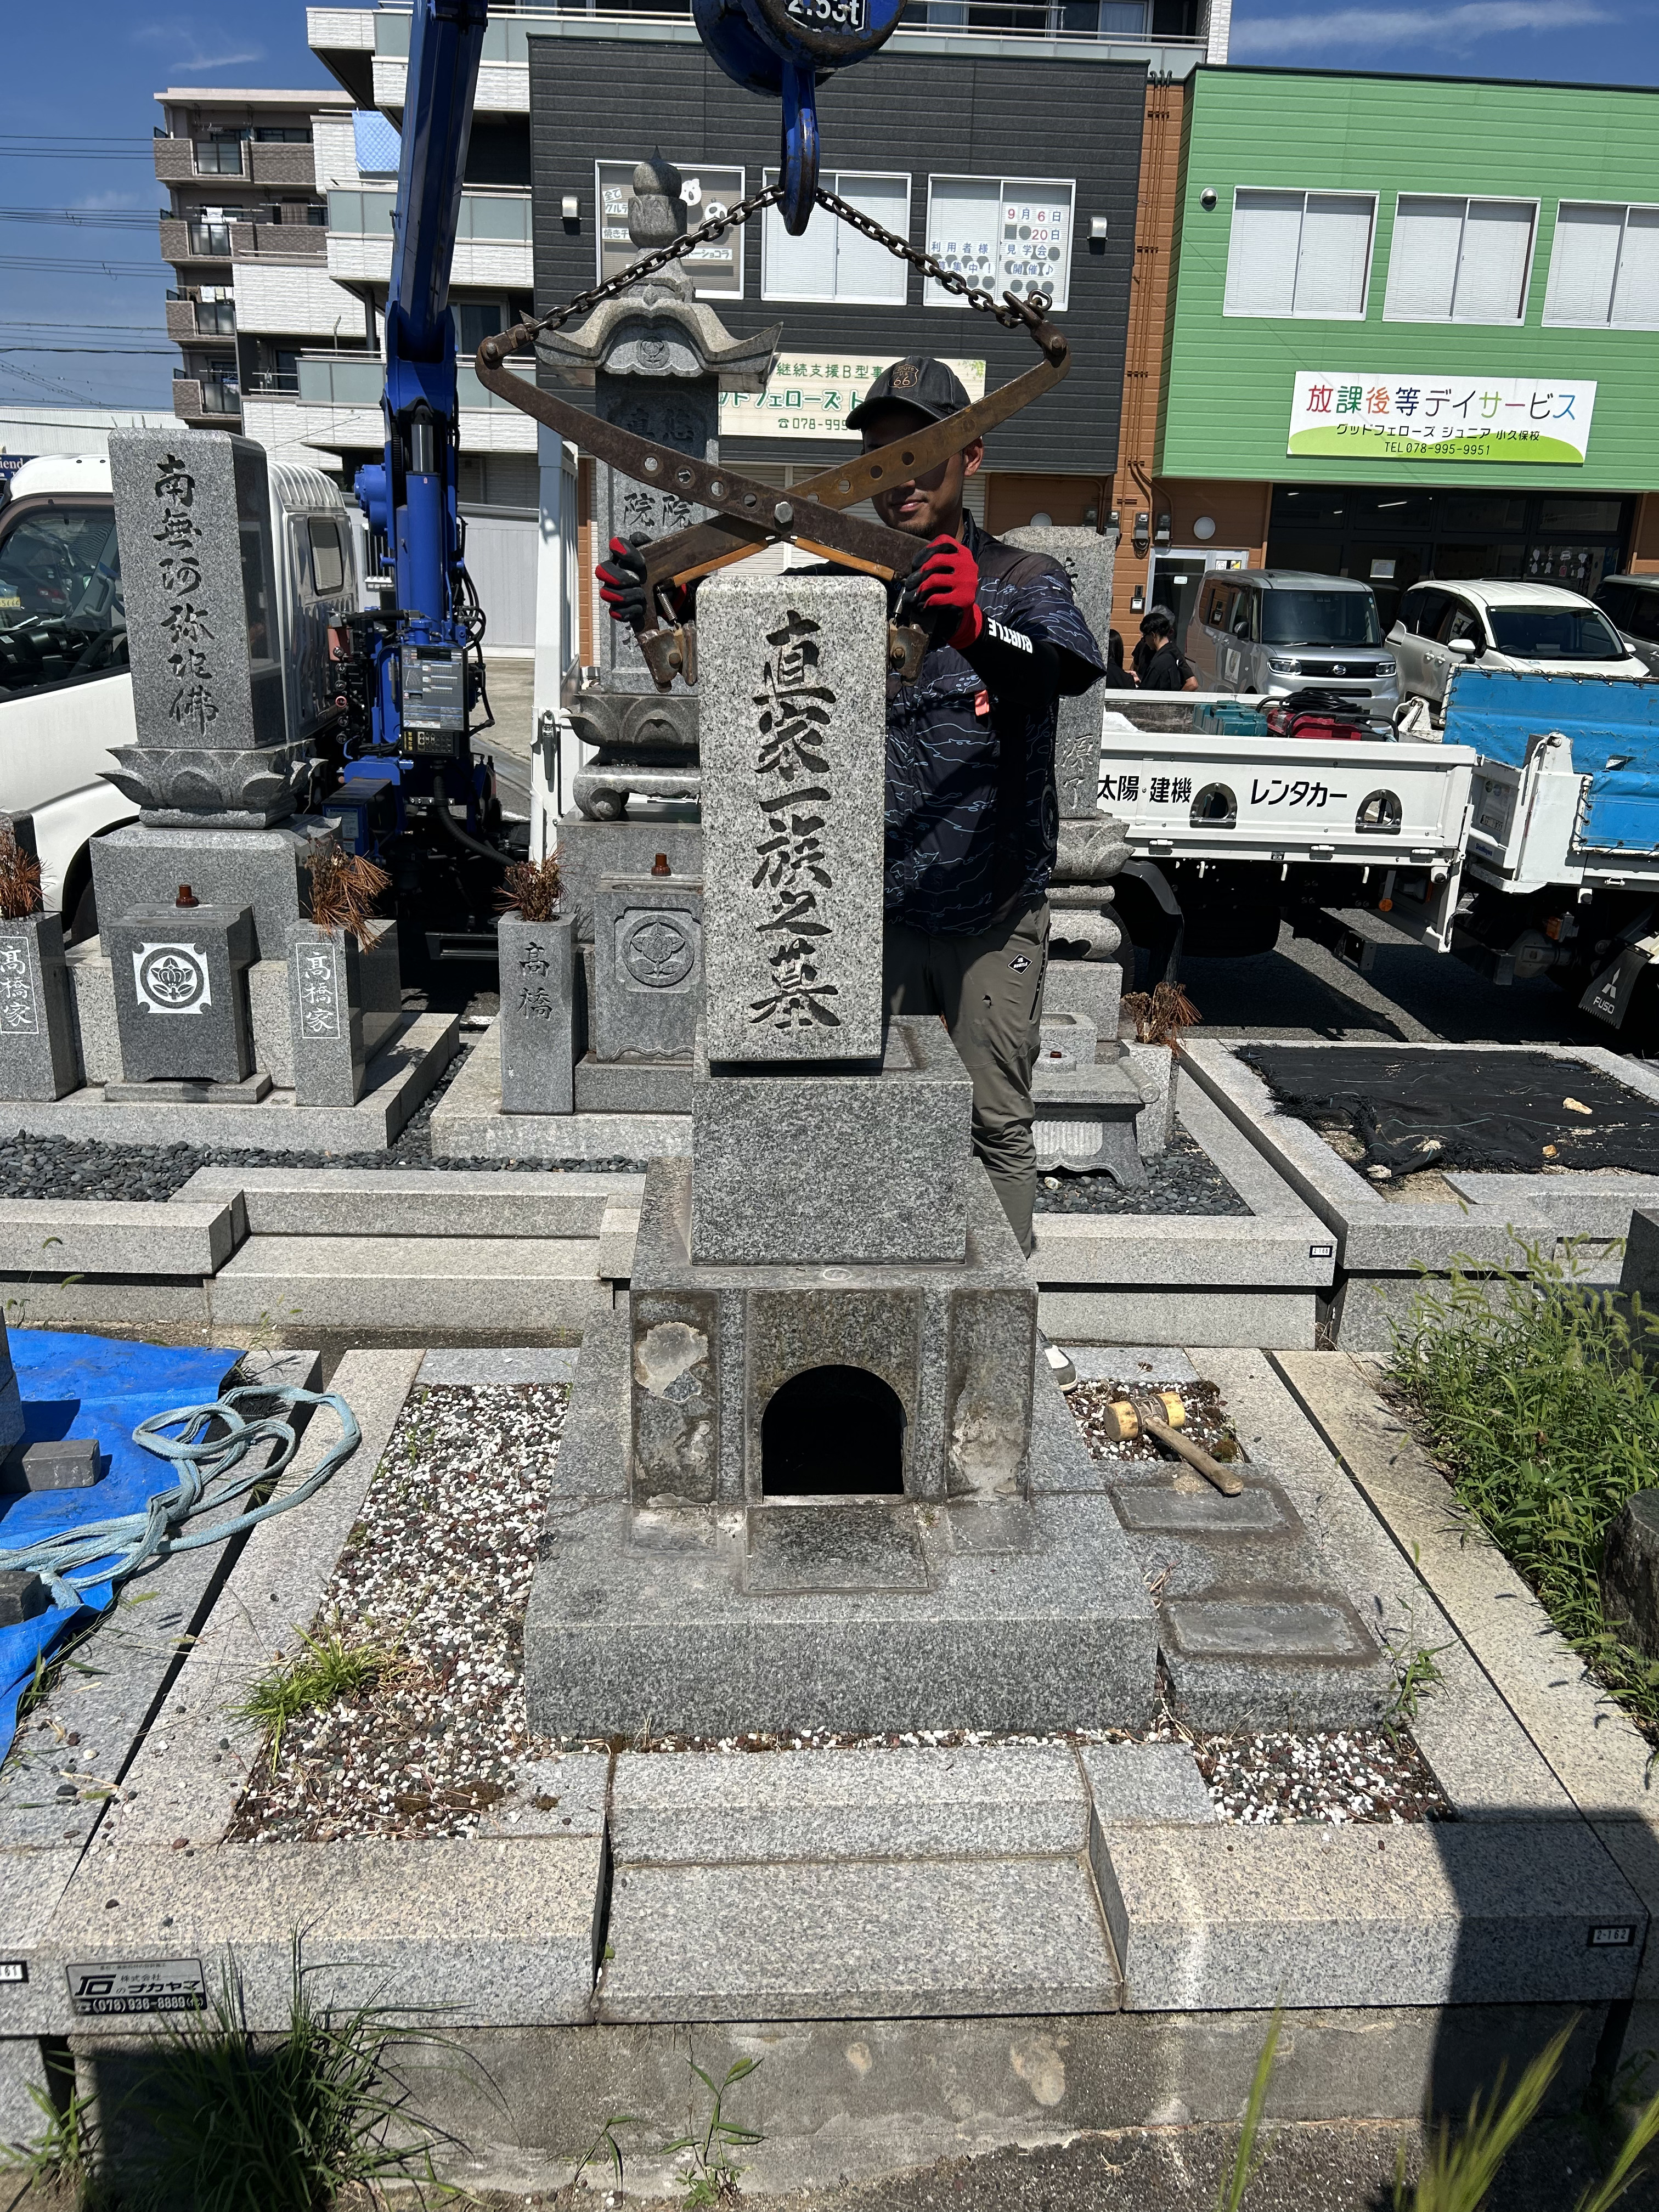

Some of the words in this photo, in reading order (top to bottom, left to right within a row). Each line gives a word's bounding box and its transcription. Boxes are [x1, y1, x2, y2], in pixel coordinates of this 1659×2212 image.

[605, 189, 621, 201] 全て
[1008, 208, 1061, 222] 9月6日
[1032, 229, 1059, 241] 20日
[684, 249, 729, 258] ーショコラ
[932, 241, 988, 254] 利用者様
[1007, 244, 1047, 256] 見学会
[777, 363, 884, 380] 継続支援B型事
[894, 376, 910, 386] 66
[1306, 384, 1576, 421] 放課後等デイサービス
[1336, 423, 1435, 438] グッドフェローズ
[1442, 426, 1491, 440] ジュニア
[1496, 430, 1540, 441] 小久保校
[988, 617, 1032, 653] BURTLE
[1251, 779, 1347, 807] レンタカー
[1593, 996, 1615, 1014] FUSO
[1596, 1929, 1626, 1940] 2-162
[0, 1966, 17, 1977] 61
[121, 1973, 162, 1983] 株式会社
